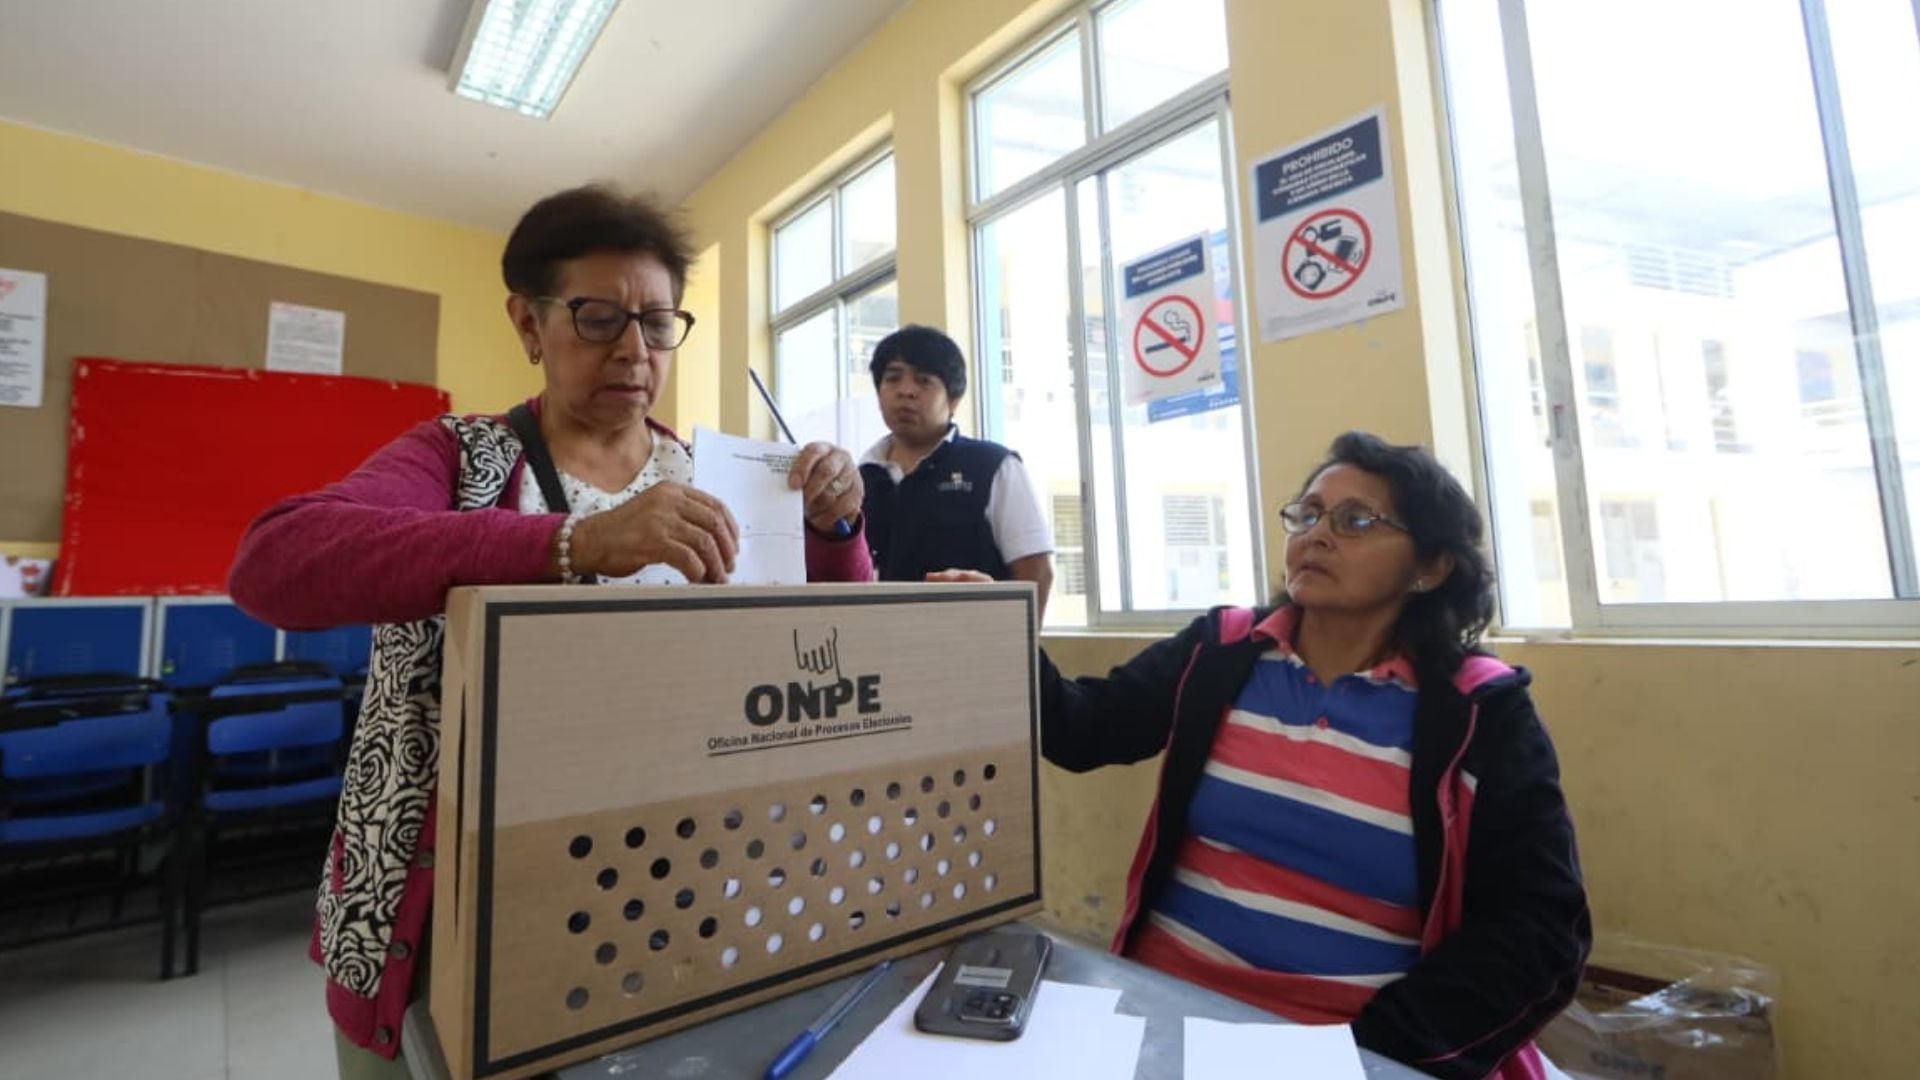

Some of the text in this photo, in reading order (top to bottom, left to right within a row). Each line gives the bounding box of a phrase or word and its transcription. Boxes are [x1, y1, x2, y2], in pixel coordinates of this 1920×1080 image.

[1282, 137, 1353, 174] PROHIBIDO
[745, 674, 881, 727] ONPE
[707, 735, 748, 750] Oficina
[751, 727, 797, 744] Nacional
[800, 726, 813, 737] de
[815, 720, 860, 736] Procesos
